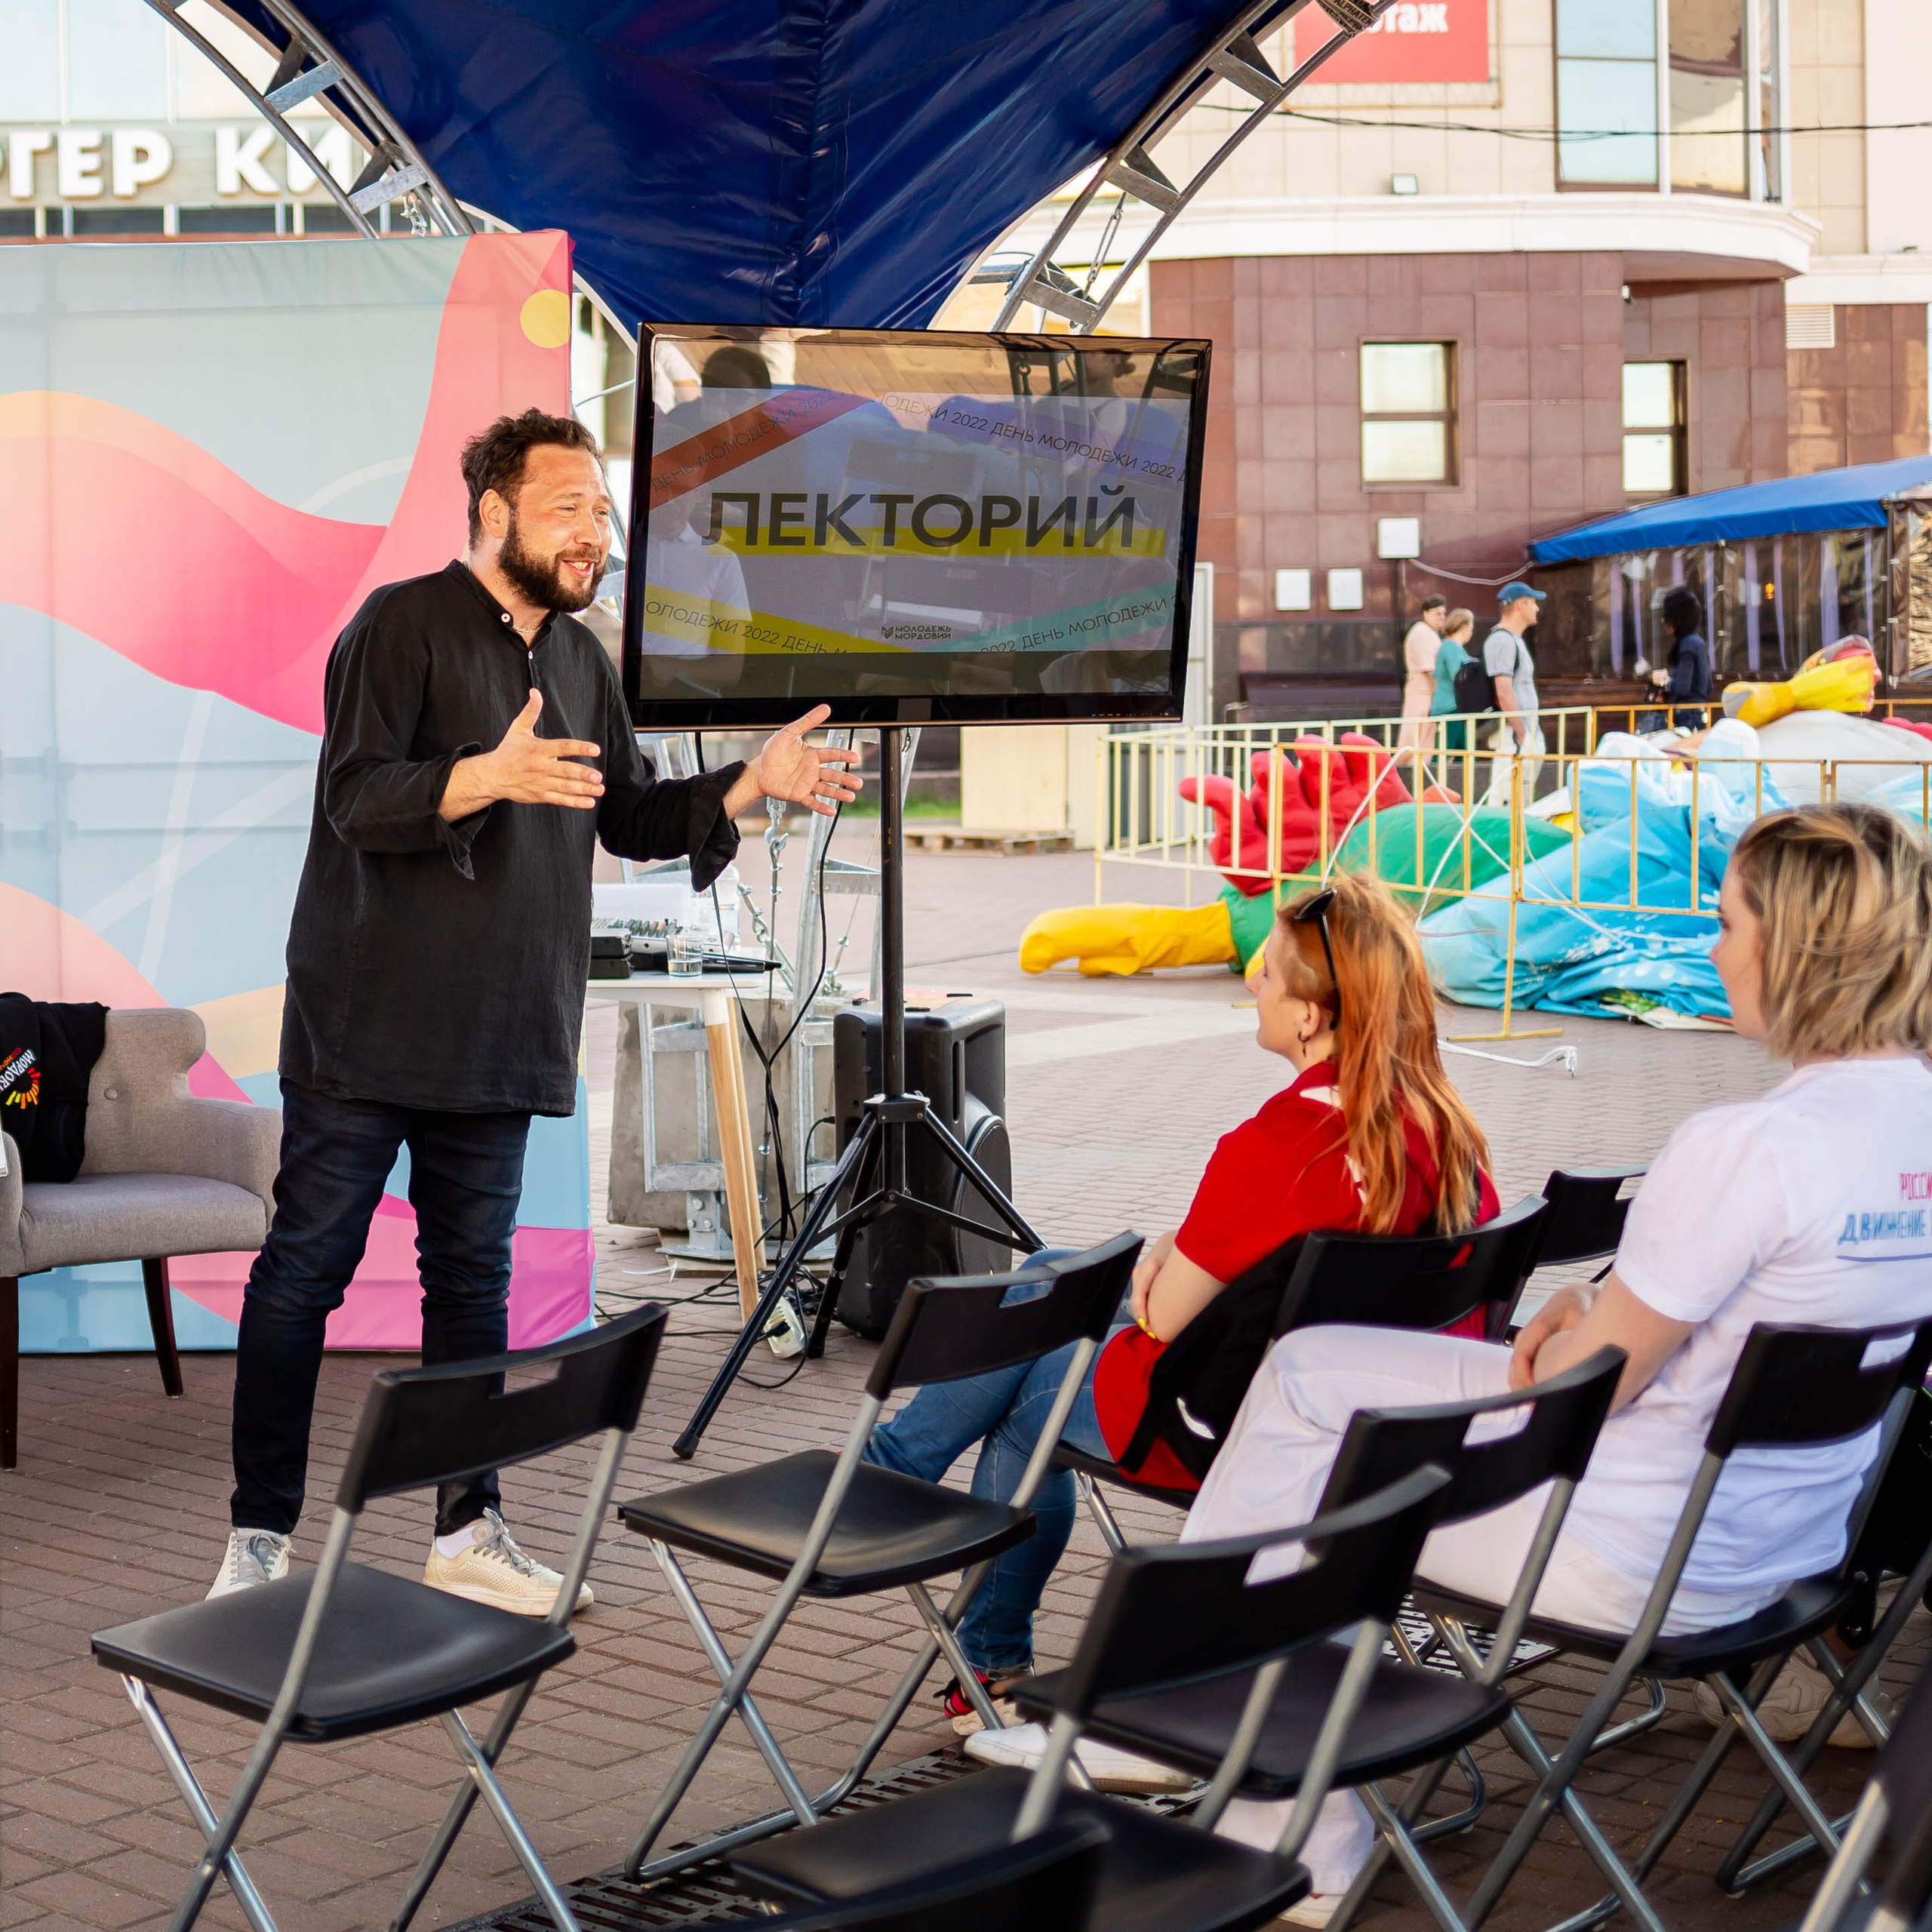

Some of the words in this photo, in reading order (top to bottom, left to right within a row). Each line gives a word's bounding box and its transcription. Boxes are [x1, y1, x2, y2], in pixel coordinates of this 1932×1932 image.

[1334, 0, 1377, 28] ALPHATEN
[0, 129, 174, 199] ГЕР
[216, 125, 373, 196] КИ
[652, 463, 695, 493] ДЕНЬ
[697, 408, 797, 466] МОЛОДЕЖИ
[951, 412, 989, 431] 2022
[989, 423, 1034, 442] ДЕНЬ
[1038, 433, 1138, 469] МОЛОДЕЖИ
[1141, 460, 1176, 478] 2022
[702, 485, 1135, 548] ЛЕКТОРИЙ
[742, 625, 780, 645] 2022
[1022, 628, 1064, 650] ДЕНЬ
[1069, 598, 1167, 635] МОЛОДЕЖИ
